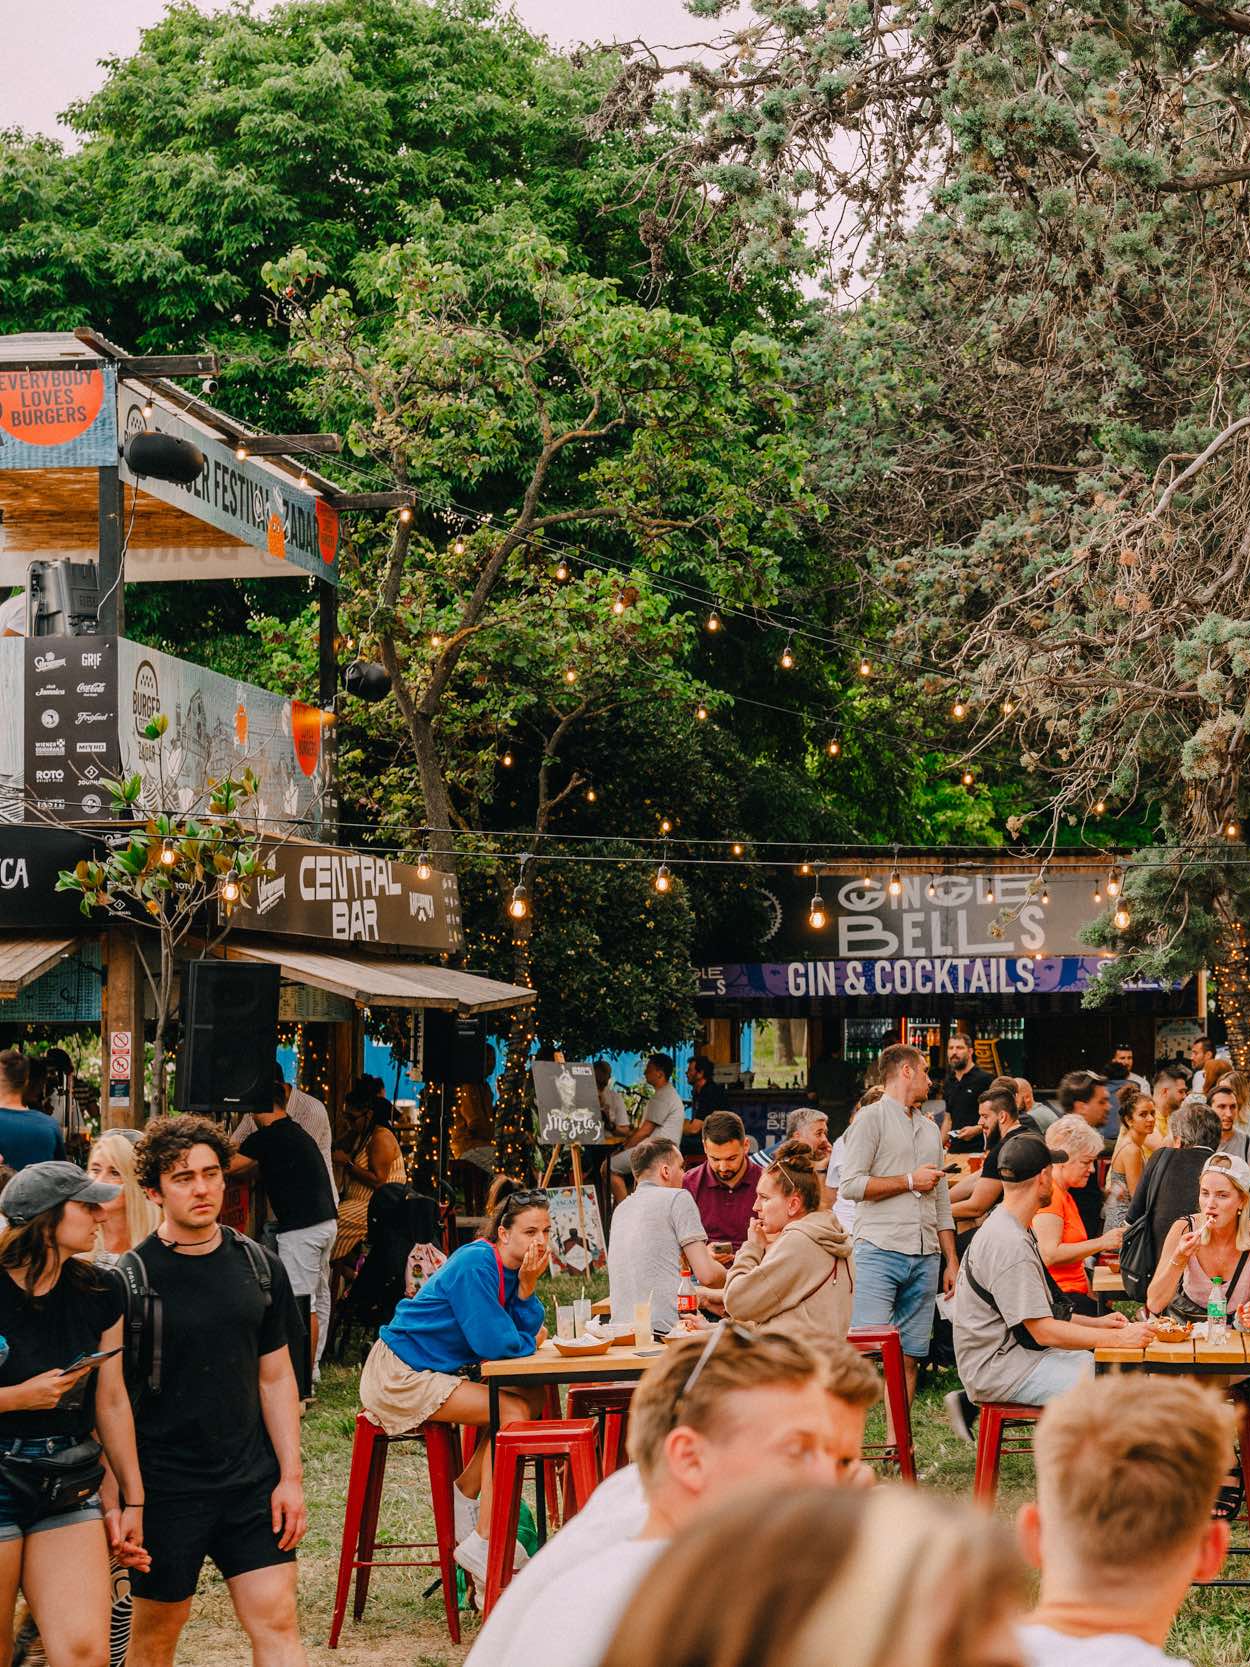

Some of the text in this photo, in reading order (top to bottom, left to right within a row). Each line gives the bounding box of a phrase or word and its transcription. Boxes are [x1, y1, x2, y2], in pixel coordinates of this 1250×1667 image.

[0, 370, 92, 391] EVERYBODY
[21, 388, 74, 408] LOVES
[11, 406, 87, 427] BURGERS
[133, 691, 160, 718] BURGER
[300, 855, 402, 900] CENTRAL
[837, 875, 1040, 912] GINGLE
[332, 899, 379, 942] BAR
[787, 957, 1035, 997] GIN & COCKTAILS
[547, 1113, 595, 1140] Mojito
